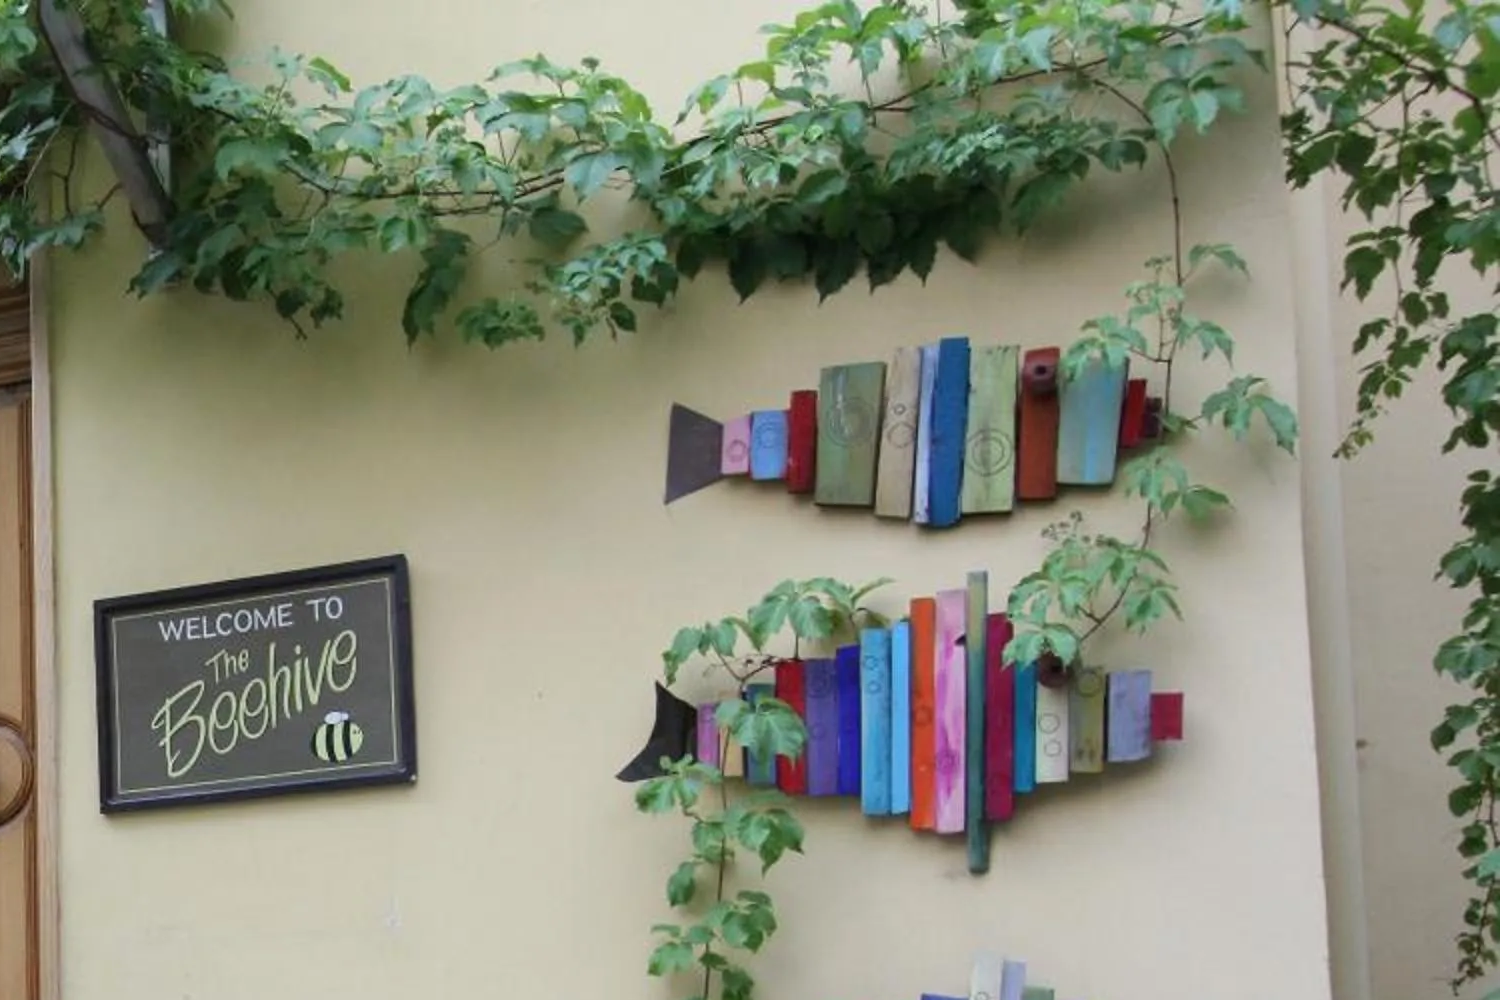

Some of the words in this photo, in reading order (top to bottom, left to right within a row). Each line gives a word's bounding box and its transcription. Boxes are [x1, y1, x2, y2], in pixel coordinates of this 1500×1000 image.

[158, 603, 293, 641] WELCOME
[306, 596, 343, 622] TO
[205, 649, 249, 683] The
[151, 629, 357, 778] Beehive
